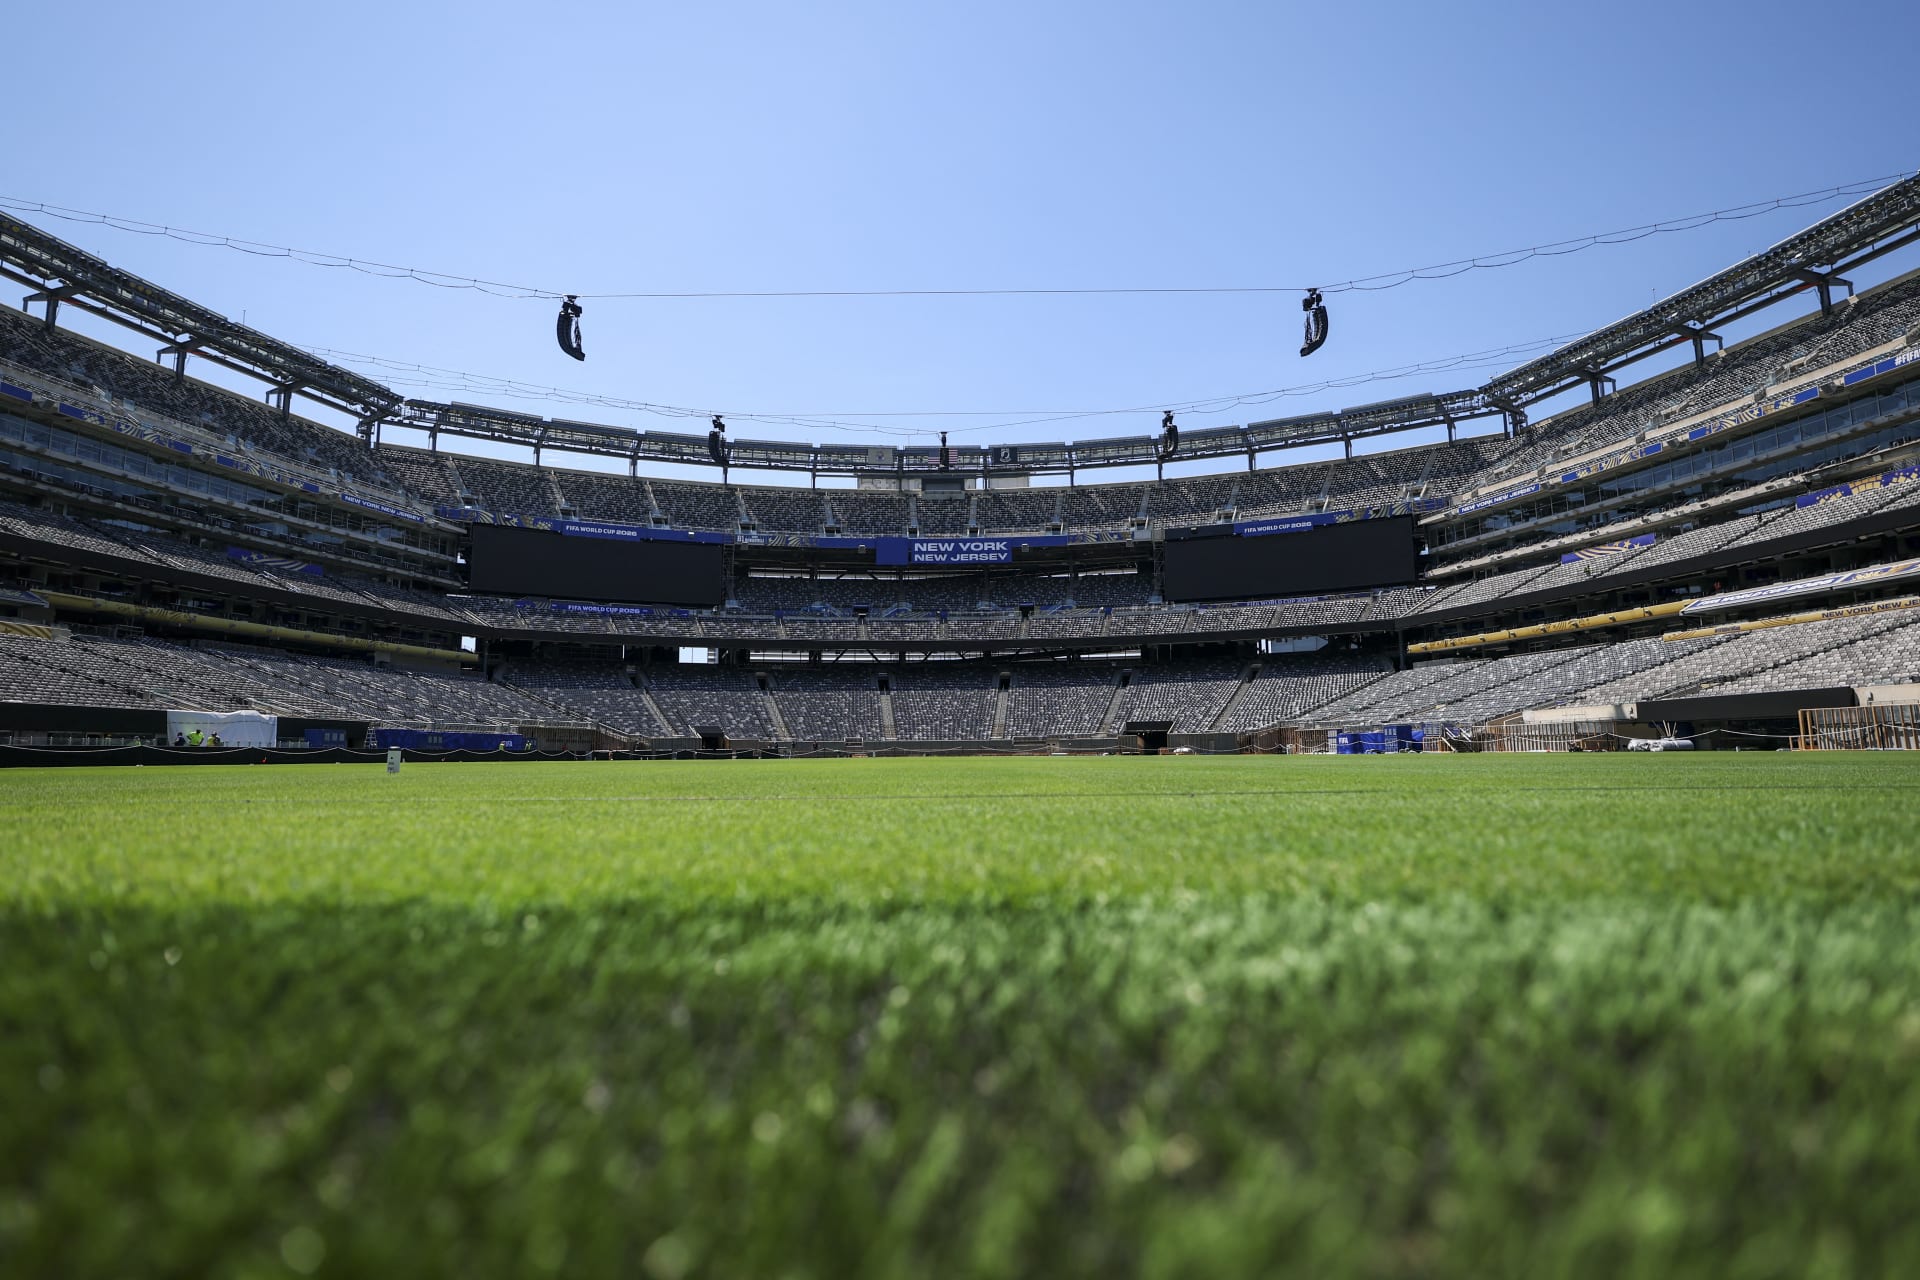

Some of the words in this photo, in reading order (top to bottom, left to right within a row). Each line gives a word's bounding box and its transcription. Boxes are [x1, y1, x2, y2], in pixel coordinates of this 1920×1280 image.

[1894, 347, 1920, 366] #FIFA
[1476, 499, 1493, 508] YORK
[1494, 494, 1509, 502] NEW
[1509, 485, 1536, 498] JERSEY
[345, 495, 361, 504] NEW
[362, 500, 380, 510] YORK
[381, 506, 396, 514] NEW
[397, 510, 420, 520] JERSEY
[1291, 521, 1312, 529] 2026
[914, 542, 955, 552] NEW
[959, 541, 1008, 551] YORK
[914, 553, 948, 562] NEW
[950, 552, 1008, 560] JERSEY
[1260, 598, 1282, 606] WORLD
[1821, 610, 1844, 618] NEW
[1846, 606, 1874, 614] YORK
[1877, 602, 1902, 610] NEW
[1904, 599, 1920, 607] JE
